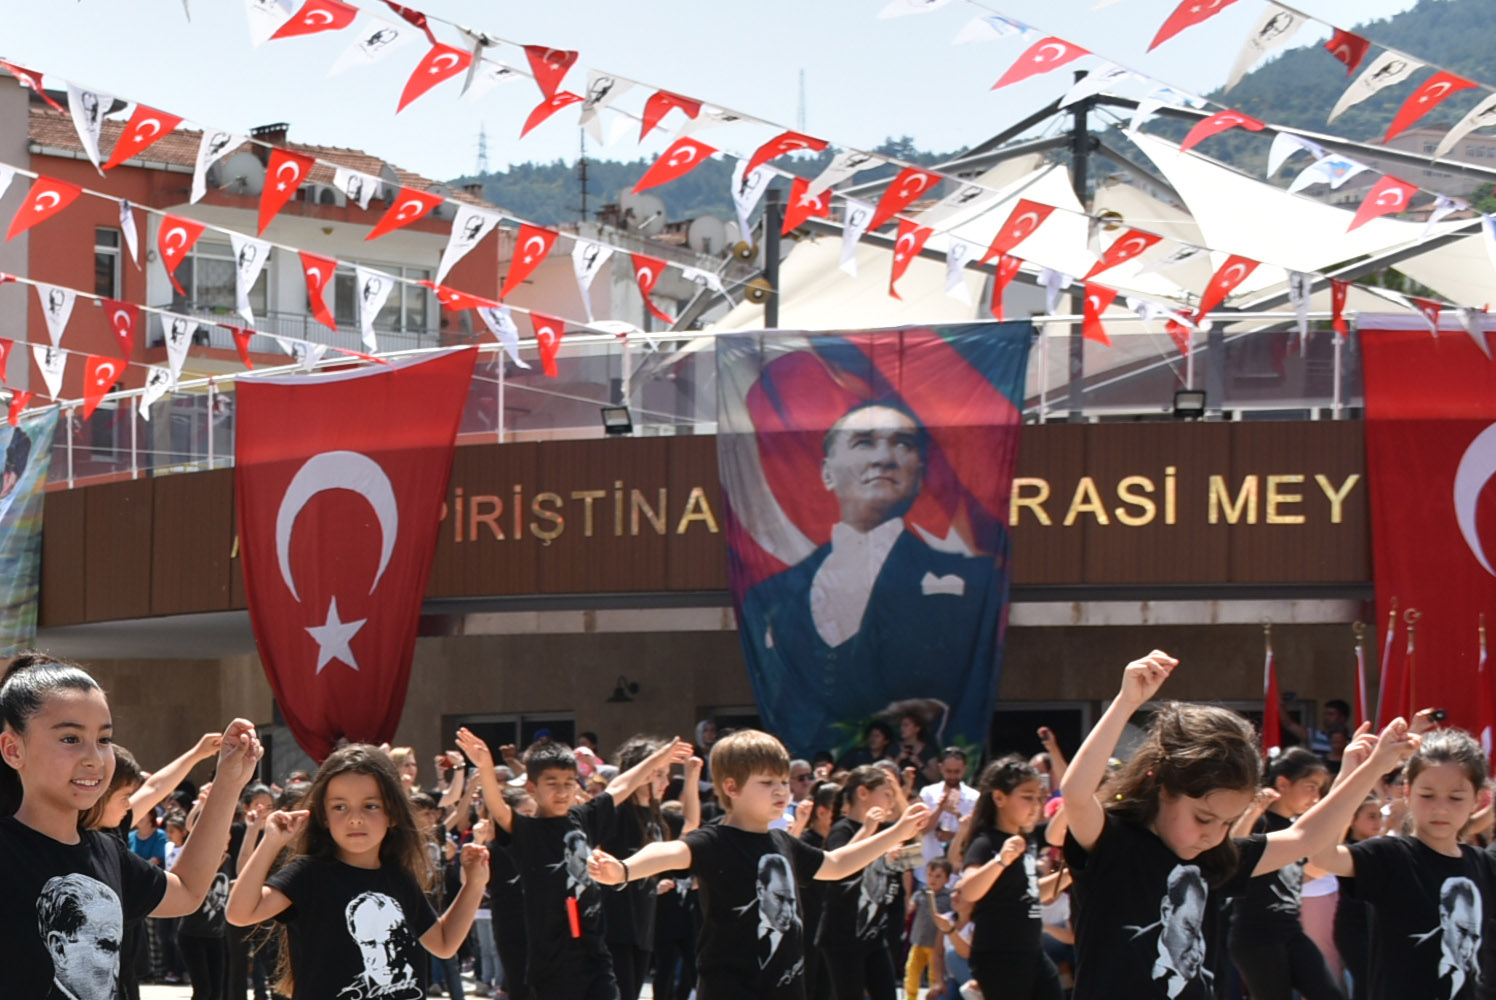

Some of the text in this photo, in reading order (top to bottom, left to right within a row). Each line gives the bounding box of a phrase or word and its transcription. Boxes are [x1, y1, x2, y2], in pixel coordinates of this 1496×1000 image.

[440, 466, 1361, 546] İRİŞTİNA RASİ MEY
